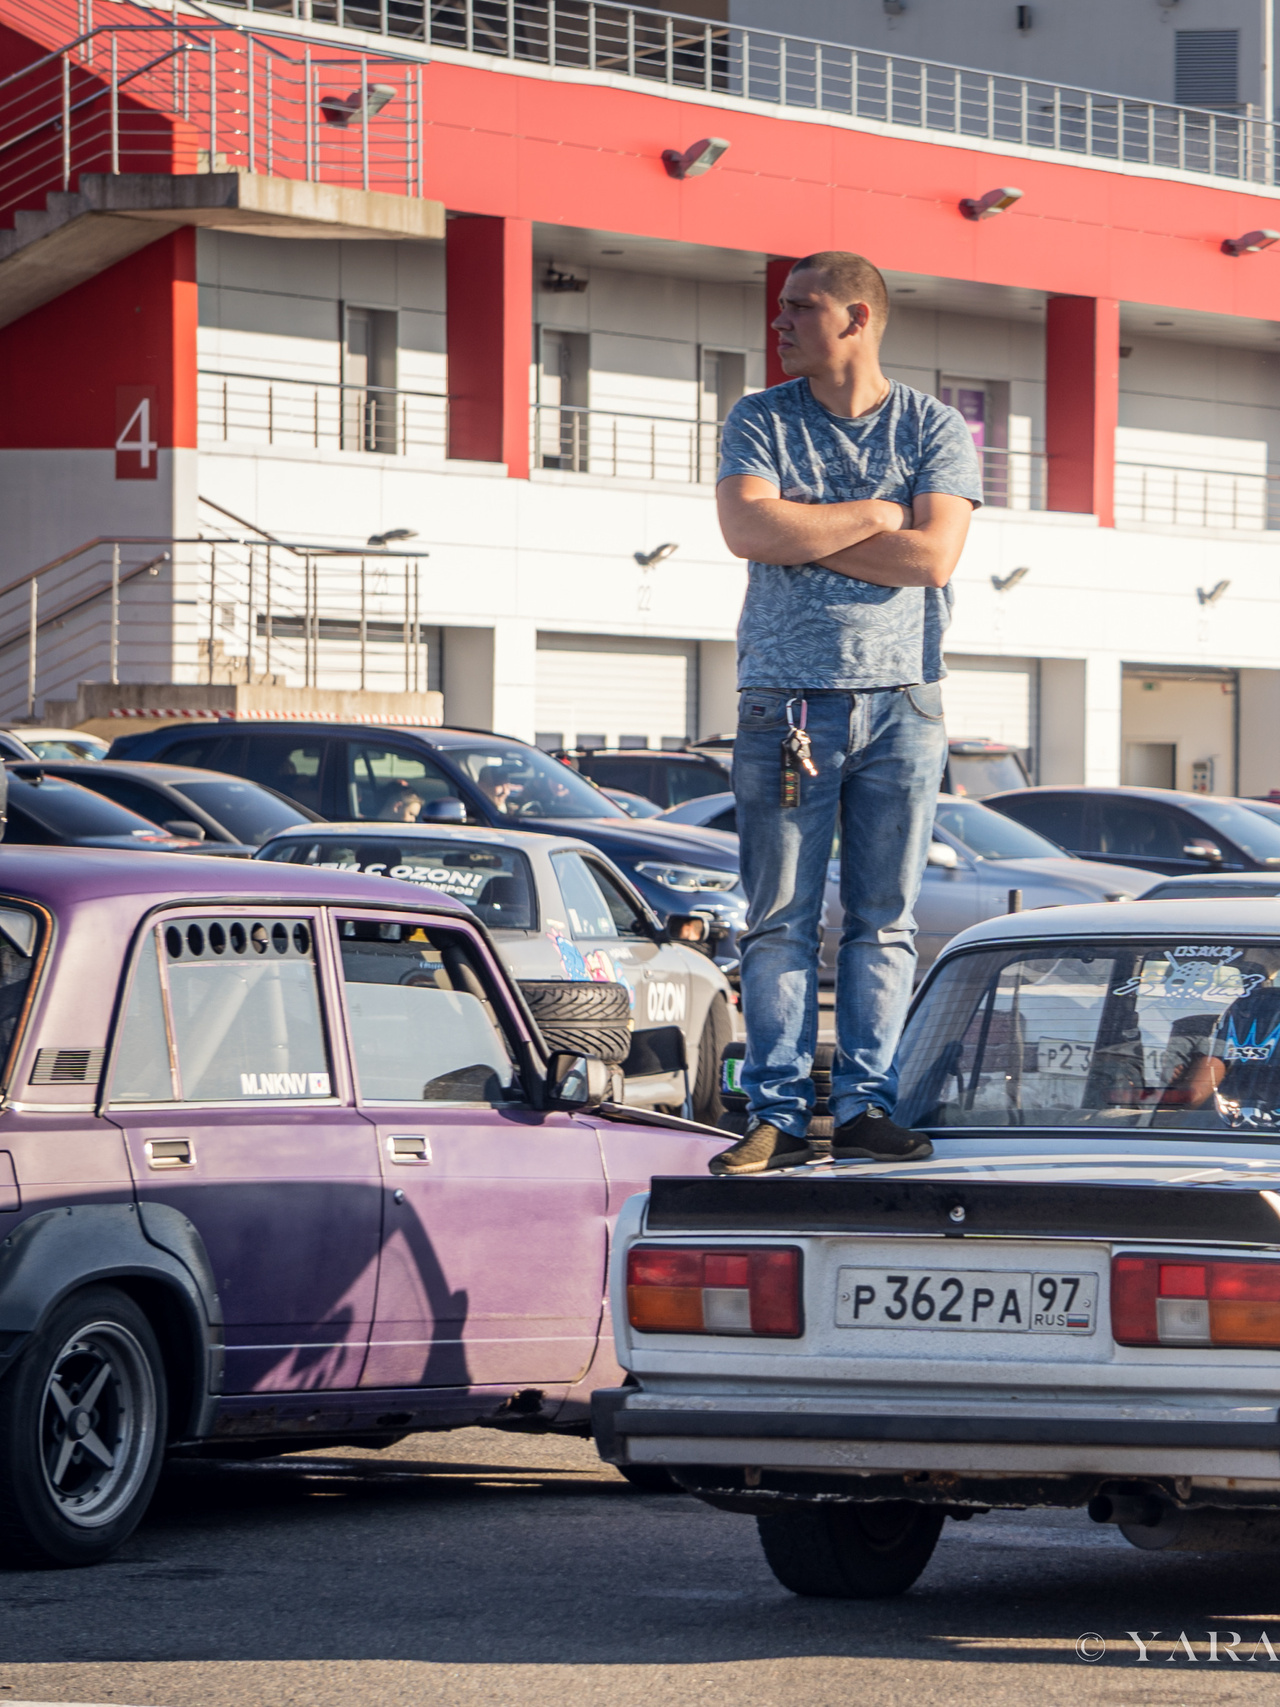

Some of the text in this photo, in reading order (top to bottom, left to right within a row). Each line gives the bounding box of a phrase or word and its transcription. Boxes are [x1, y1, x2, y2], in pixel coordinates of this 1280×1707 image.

[116, 398, 158, 469] 4
[389, 864, 483, 888] OZON!
[1173, 945, 1235, 957] OSAKA
[647, 982, 686, 1022] OZON
[1037, 1277, 1081, 1313] 97
[1034, 1314, 1066, 1326] RUS
